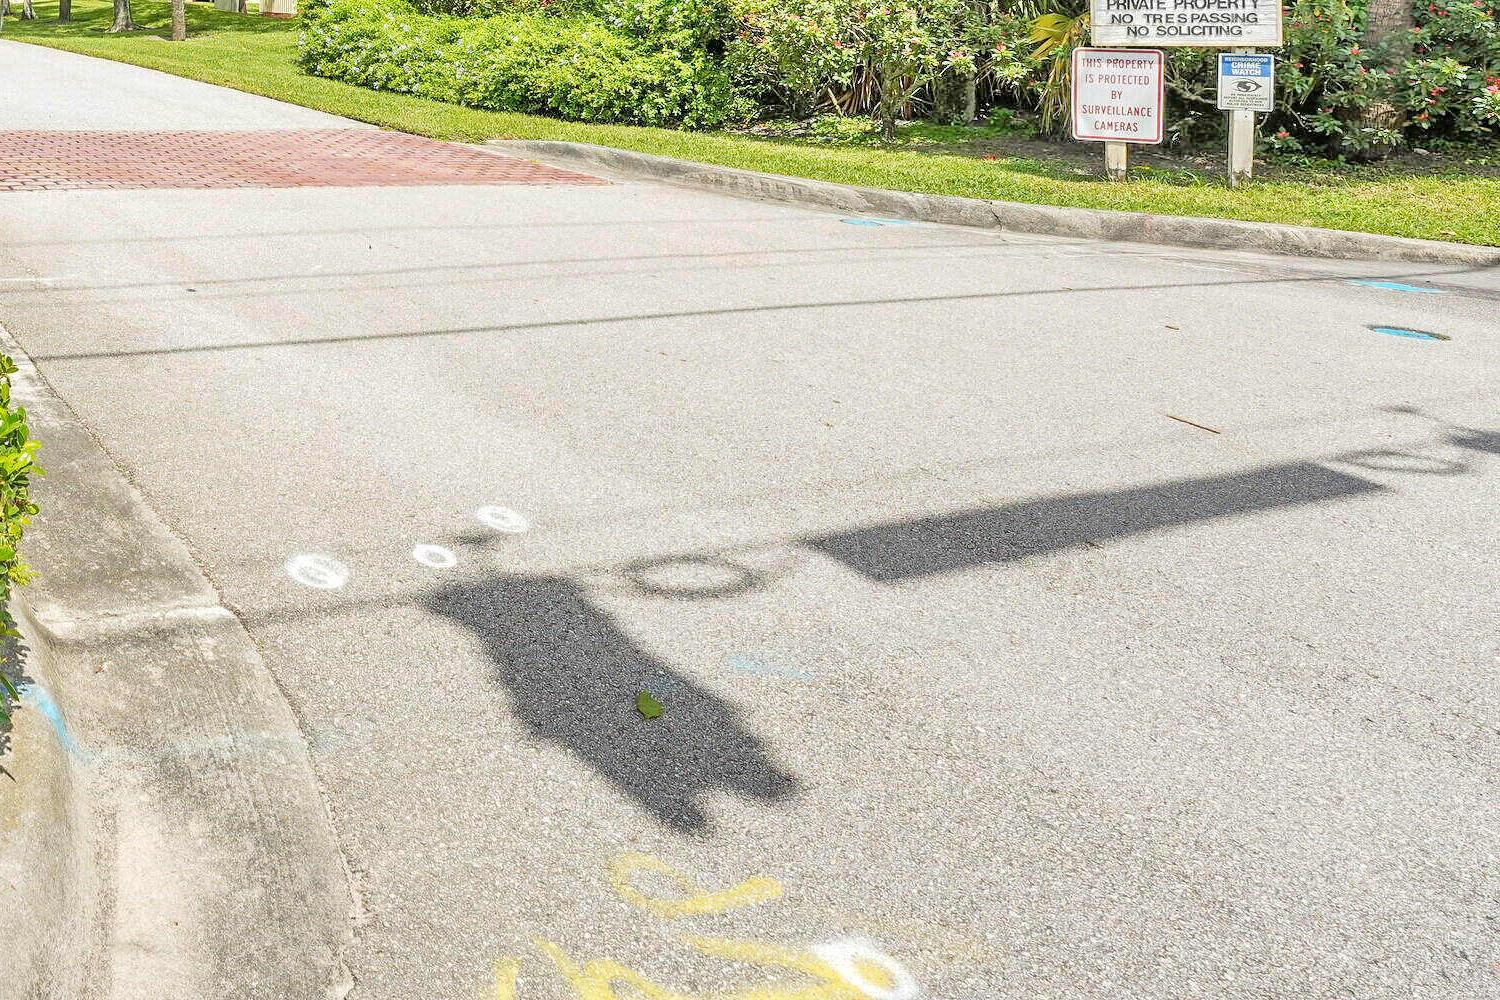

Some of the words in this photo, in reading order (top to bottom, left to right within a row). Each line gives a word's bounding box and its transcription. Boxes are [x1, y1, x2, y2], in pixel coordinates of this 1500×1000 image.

[1111, 13, 1134, 24] NO
[1144, 12, 1258, 24] TRESPASSING
[1127, 26, 1149, 37] NO
[1156, 25, 1243, 36] SOLICITING
[1082, 58, 1102, 68] THIS
[1106, 58, 1154, 70] PROPERTY
[1231, 61, 1261, 69] CRIME
[1231, 68, 1261, 76] WATCH
[1085, 73, 1094, 84] IS
[1098, 74, 1150, 85] PROTECTED
[1111, 90, 1123, 100] BY
[1082, 104, 1152, 117] SURVEILLANCE
[1094, 120, 1138, 132] CAMERAS
